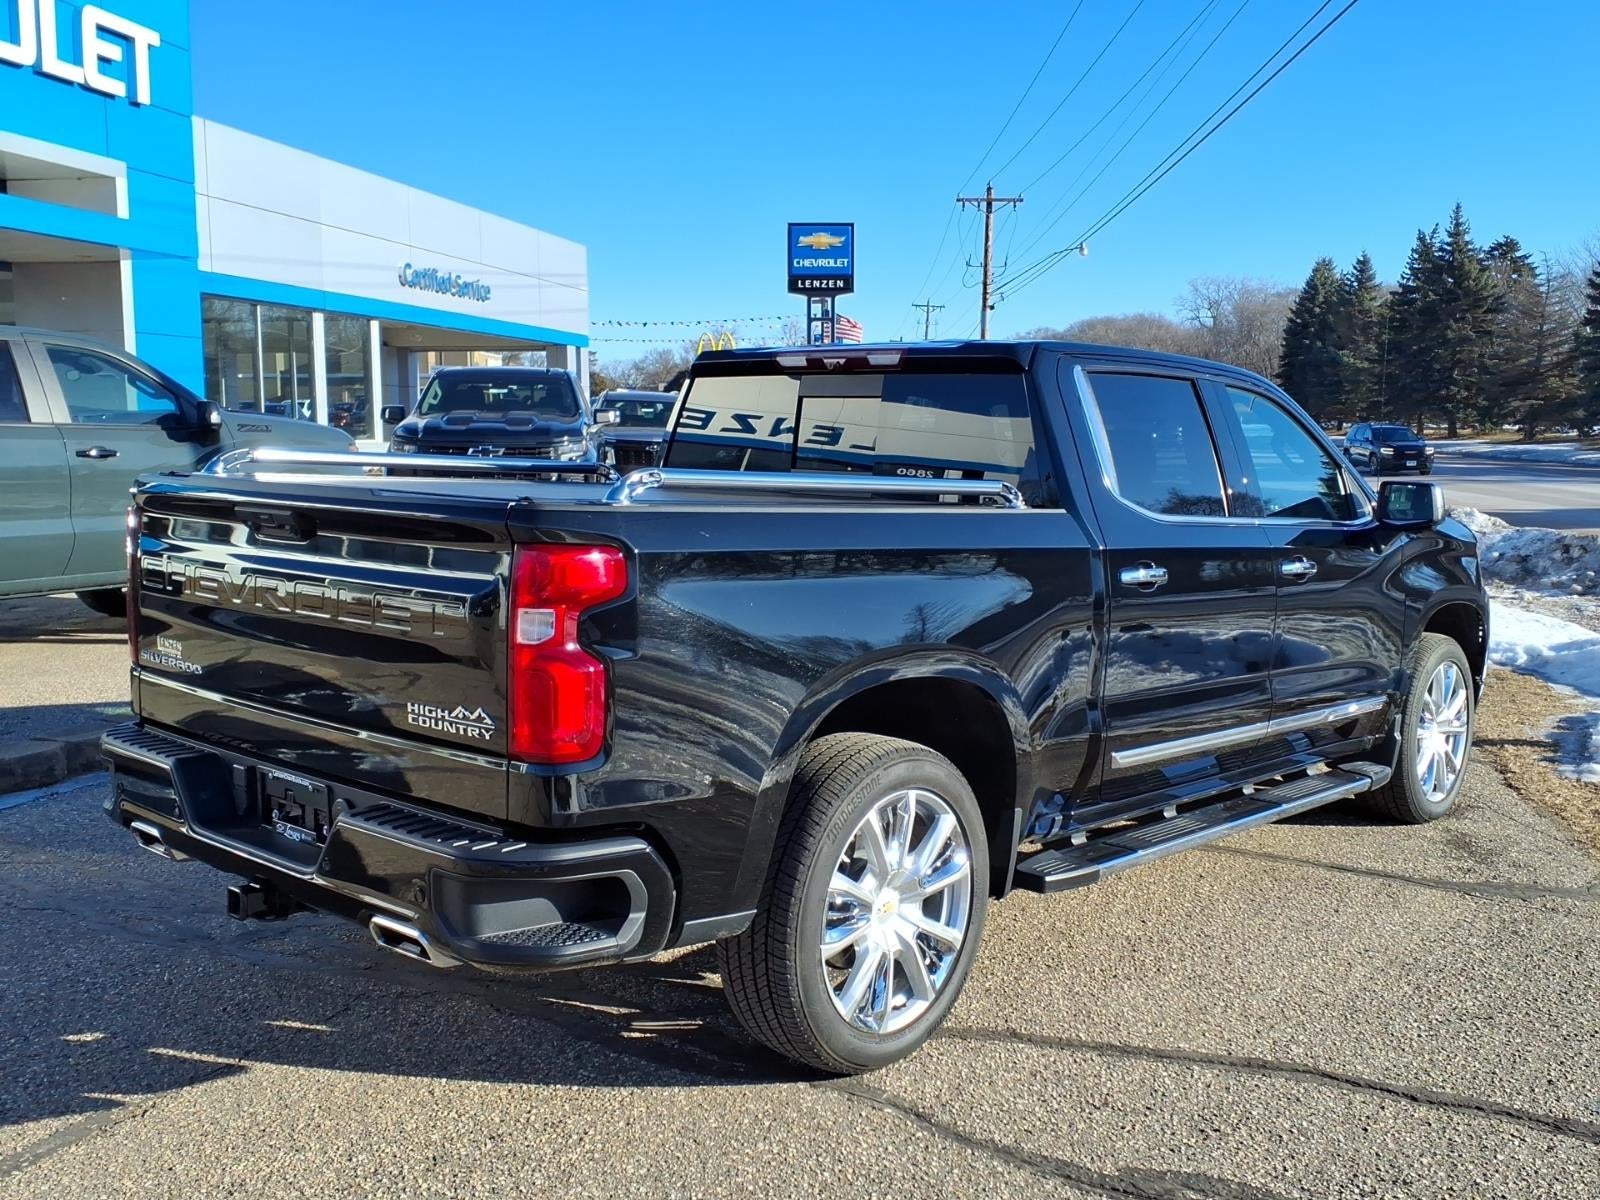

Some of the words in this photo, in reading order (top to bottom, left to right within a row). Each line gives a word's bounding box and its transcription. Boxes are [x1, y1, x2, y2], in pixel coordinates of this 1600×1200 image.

[793, 258, 849, 268] CHEVROLET
[400, 262, 452, 294] Certified
[452, 274, 491, 302] Service
[797, 279, 844, 288] LENZEN
[140, 554, 468, 637] CHEVROLET
[140, 649, 203, 674] SILVERADO
[407, 702, 449, 720] HIGH
[407, 713, 496, 740] COUNTRY
